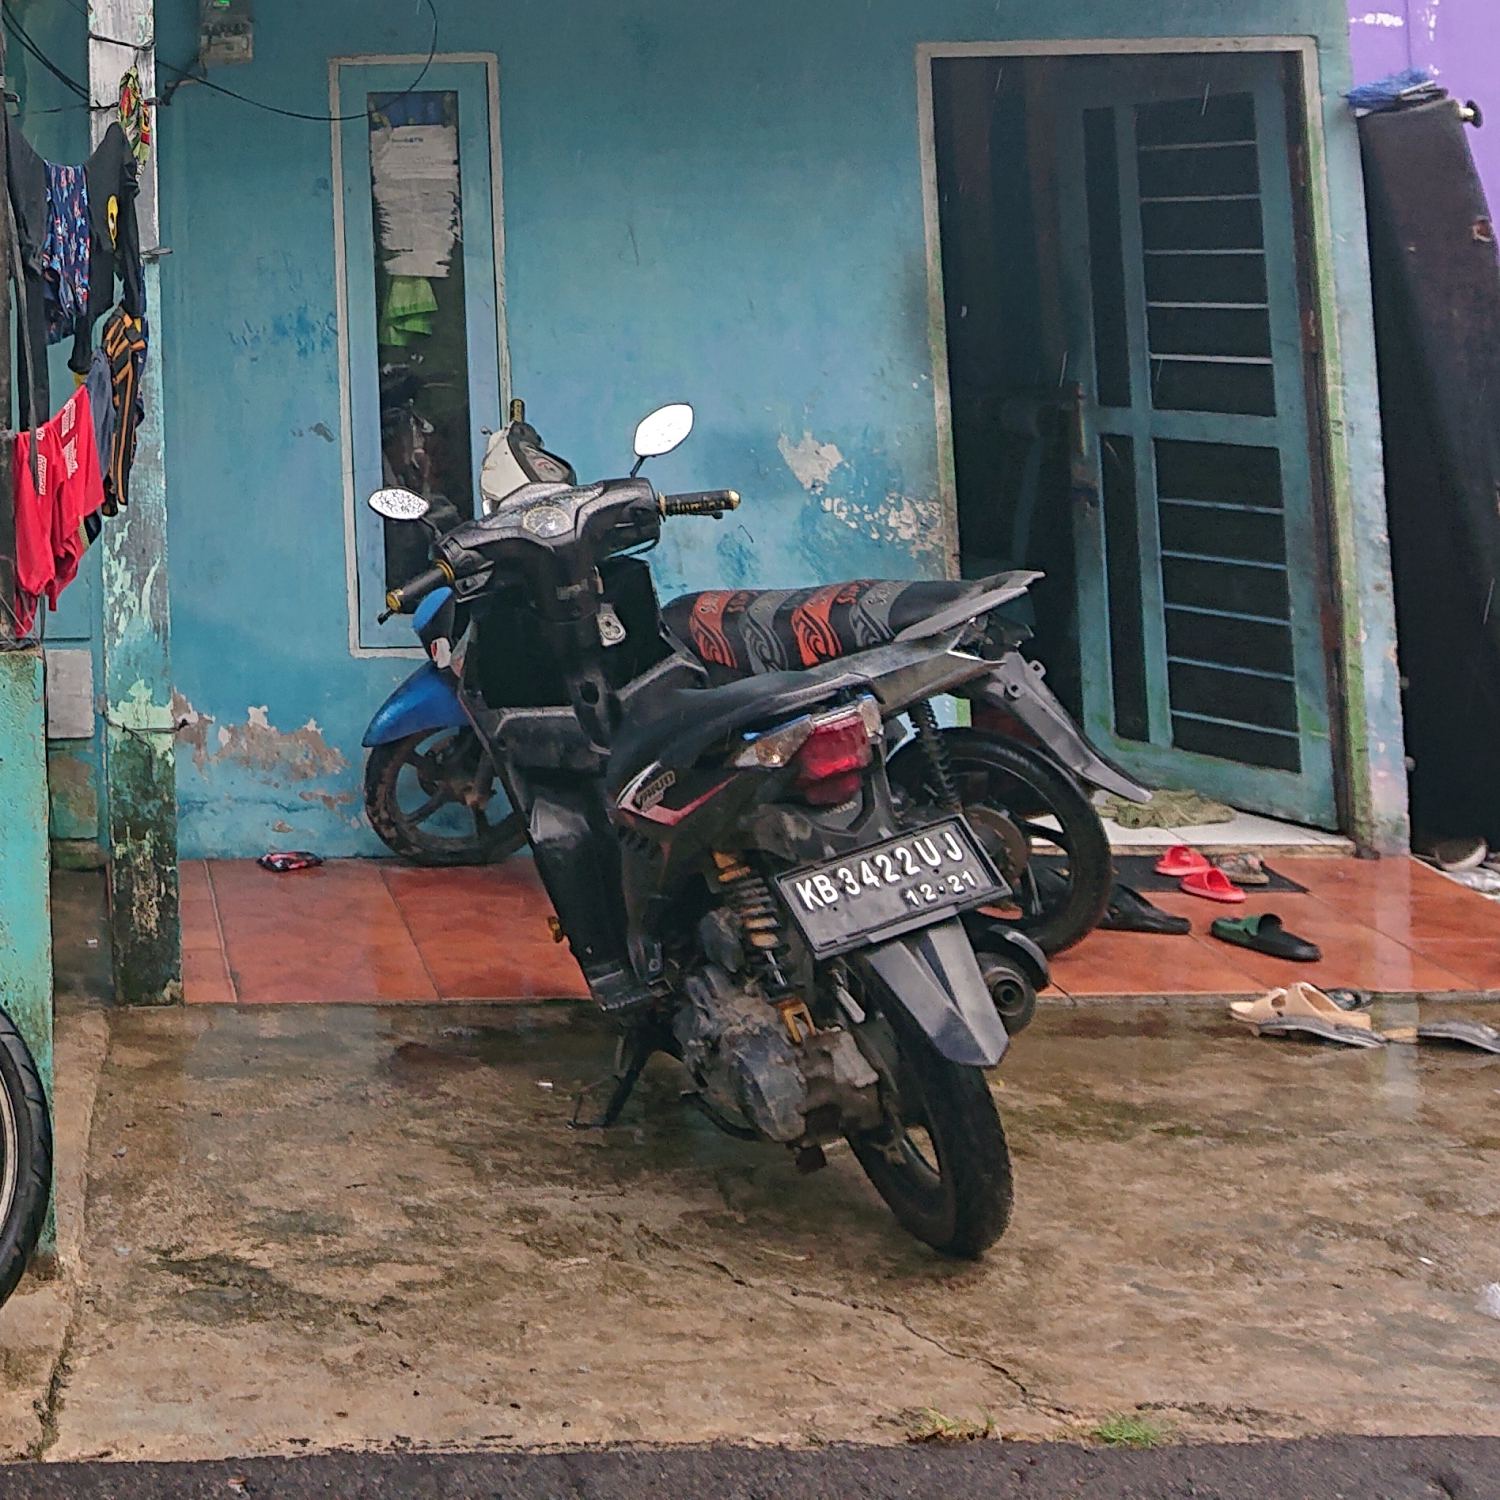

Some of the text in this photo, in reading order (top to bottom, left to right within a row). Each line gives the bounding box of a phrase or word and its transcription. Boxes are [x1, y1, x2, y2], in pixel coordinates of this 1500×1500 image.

[796, 832, 963, 910] KB 3422 UJ
